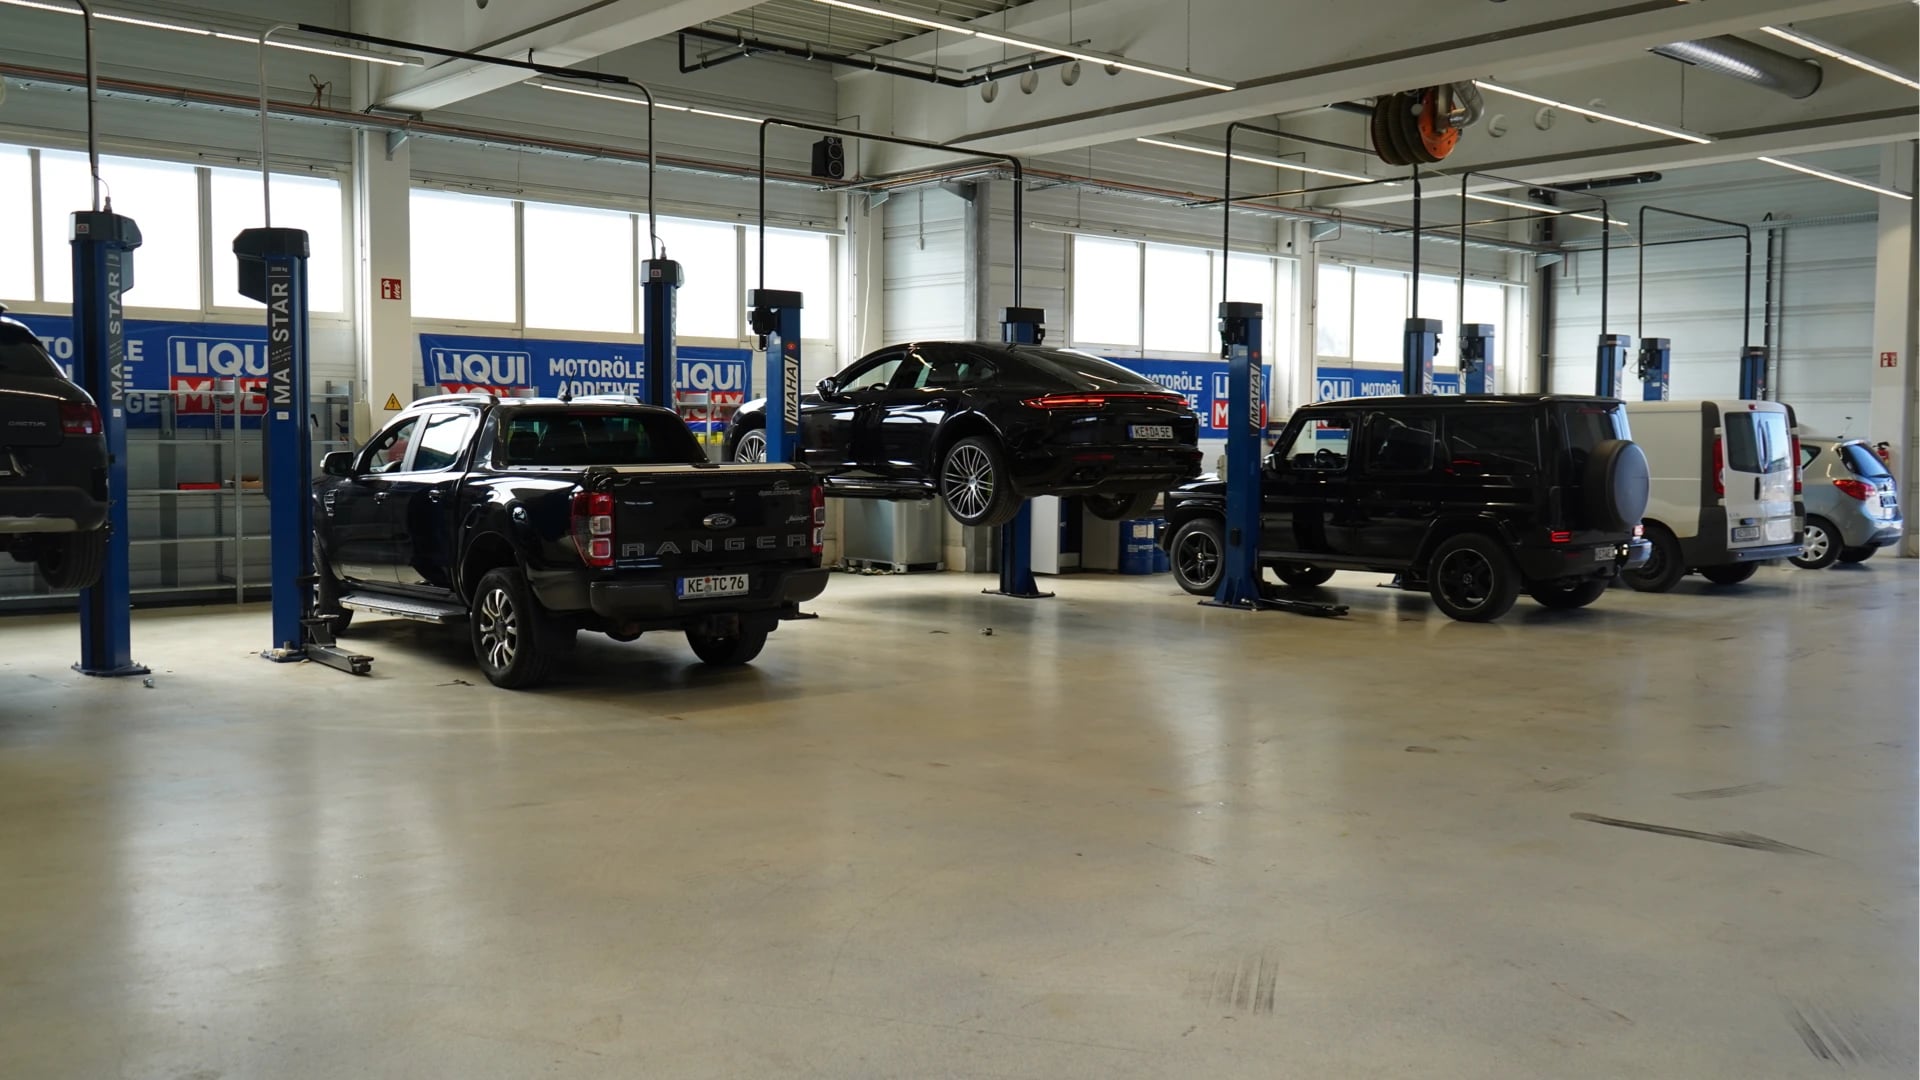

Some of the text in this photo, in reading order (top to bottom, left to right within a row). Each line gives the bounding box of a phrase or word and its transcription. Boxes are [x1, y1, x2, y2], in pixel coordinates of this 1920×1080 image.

[108, 272, 121, 334] STAR
[271, 283, 289, 342] STAR
[176, 341, 268, 376] LIQU
[436, 352, 525, 385] LIQUI
[549, 355, 645, 379] MOTORÖLE
[676, 362, 742, 391] IQUI
[785, 364, 798, 419] MAHA
[1361, 380, 1401, 396] MOTORÖL
[1251, 373, 1260, 421] MAHA
[622, 534, 806, 557] RANGER
[688, 576, 744, 593] KE TC 76
